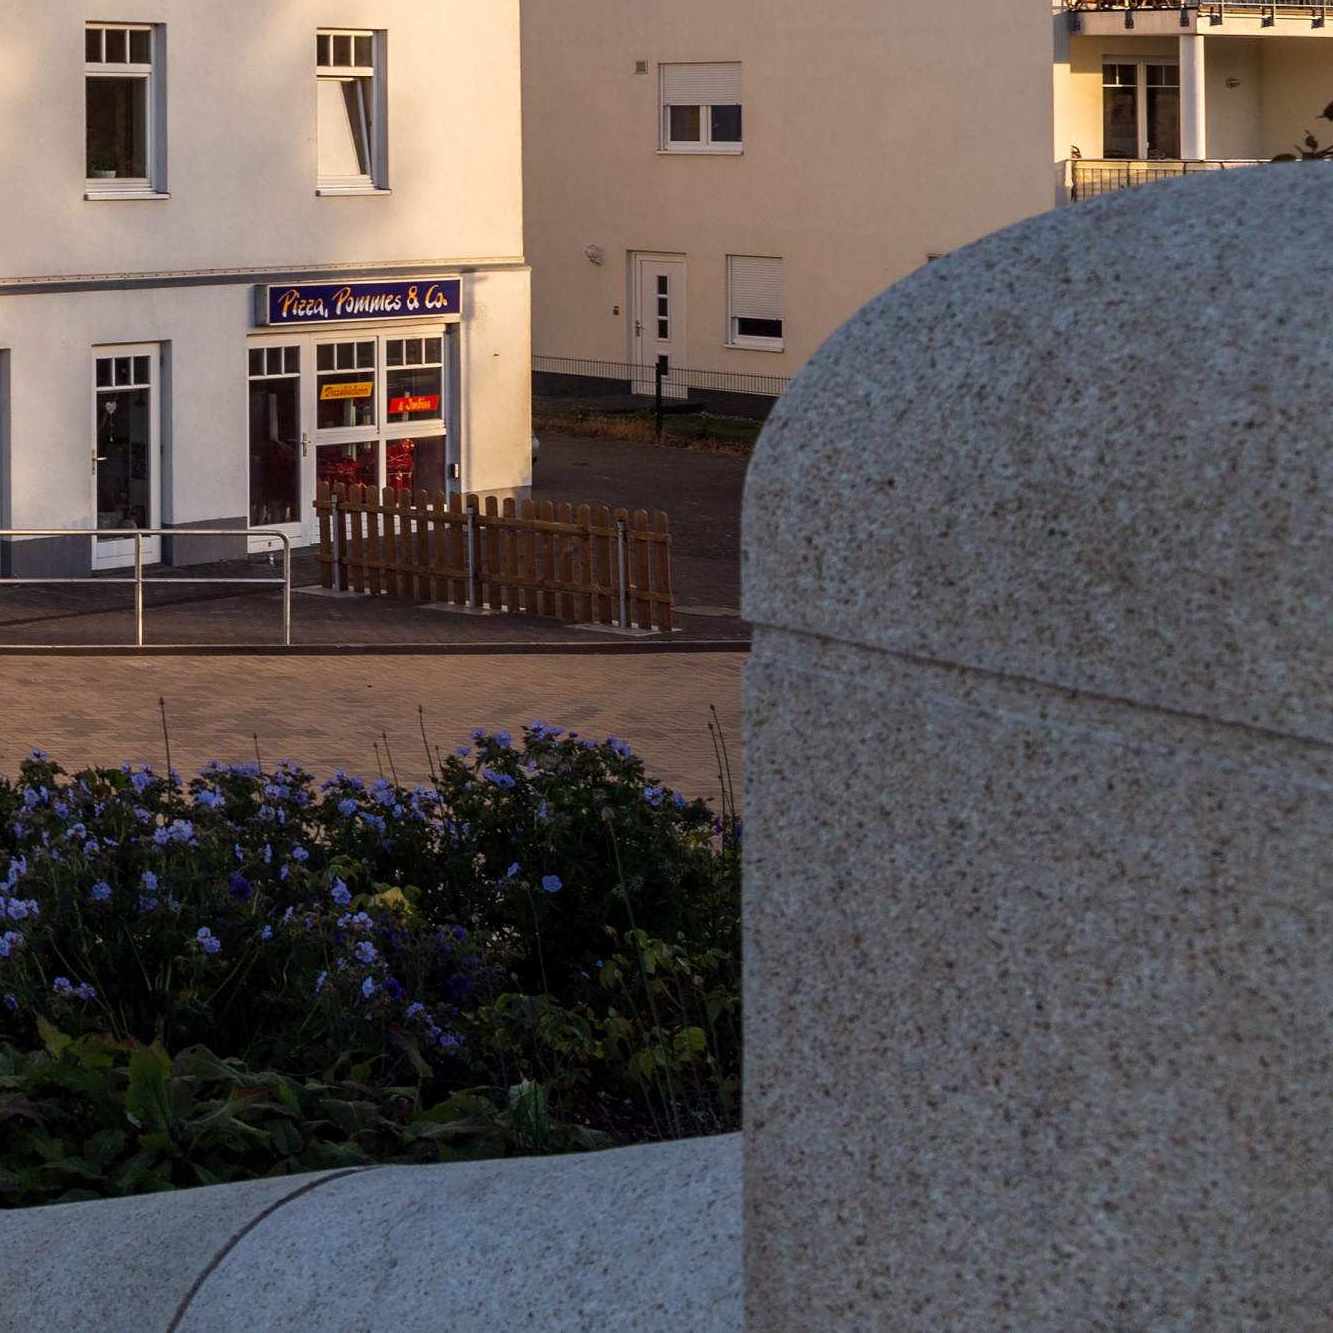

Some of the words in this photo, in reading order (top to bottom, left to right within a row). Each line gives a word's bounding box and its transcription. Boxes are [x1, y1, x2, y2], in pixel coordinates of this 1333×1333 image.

[278, 288, 329, 318] Pizza,
[332, 286, 402, 316] Pommes
[406, 285, 420, 312] &
[425, 284, 448, 309] Co.
